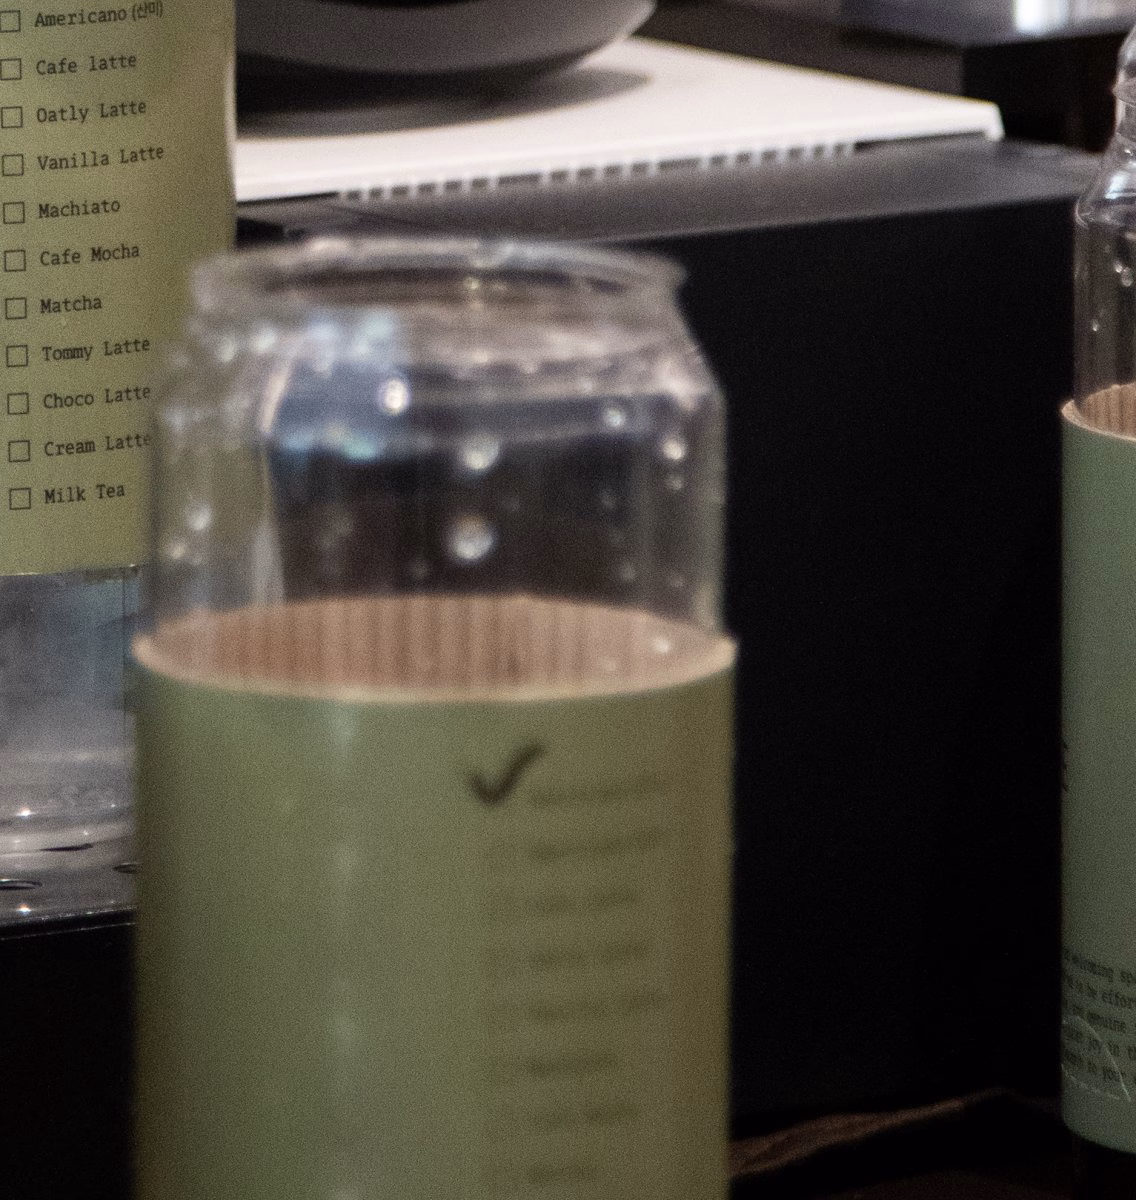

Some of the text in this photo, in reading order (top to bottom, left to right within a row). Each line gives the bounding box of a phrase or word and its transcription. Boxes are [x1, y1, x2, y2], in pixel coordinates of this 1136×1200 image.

[34, 7, 127, 27] Americano
[36, 53, 137, 76] Cafe latte
[36, 100, 147, 124] Oatly Latte
[37, 145, 165, 171] Vanilla Latte
[38, 199, 121, 219] Machiato
[39, 243, 140, 267] Cafe Mocha
[40, 294, 103, 315] Matcha
[42, 338, 151, 364] Tommy Latte
[43, 385, 152, 411] Choco Latte
[44, 439, 96, 458] Cream
[44, 481, 126, 506] Milk Tea
